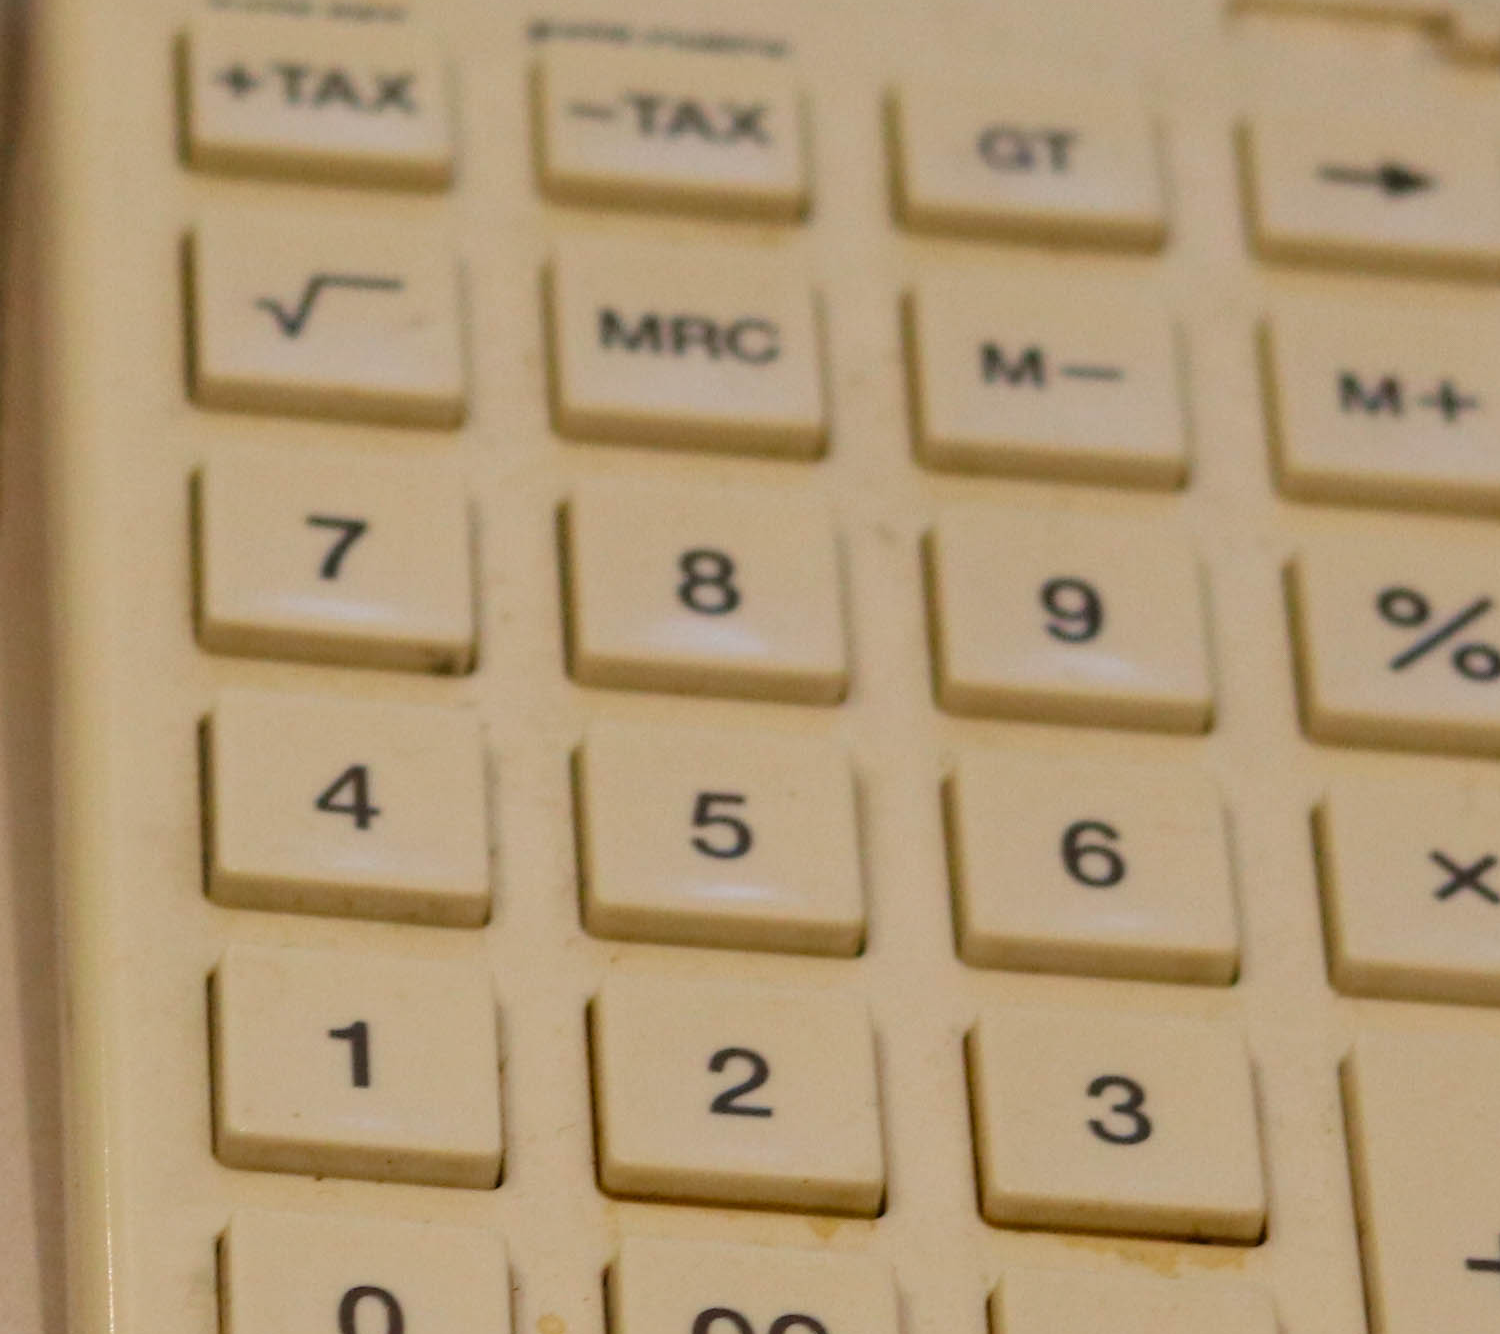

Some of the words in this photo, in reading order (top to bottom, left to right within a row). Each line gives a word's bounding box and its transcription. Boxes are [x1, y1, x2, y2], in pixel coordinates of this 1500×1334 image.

[976, 124, 1078, 171] GT
[597, 306, 779, 363] MRC
[304, 513, 371, 582] 7
[675, 547, 743, 616] 8
[1038, 576, 1106, 644] 9
[313, 763, 382, 832] 4
[689, 790, 755, 862] 5
[1059, 818, 1128, 890] 6
[326, 1018, 373, 1091] 1
[706, 1044, 775, 1120] 2
[1084, 1073, 1155, 1148] 3
